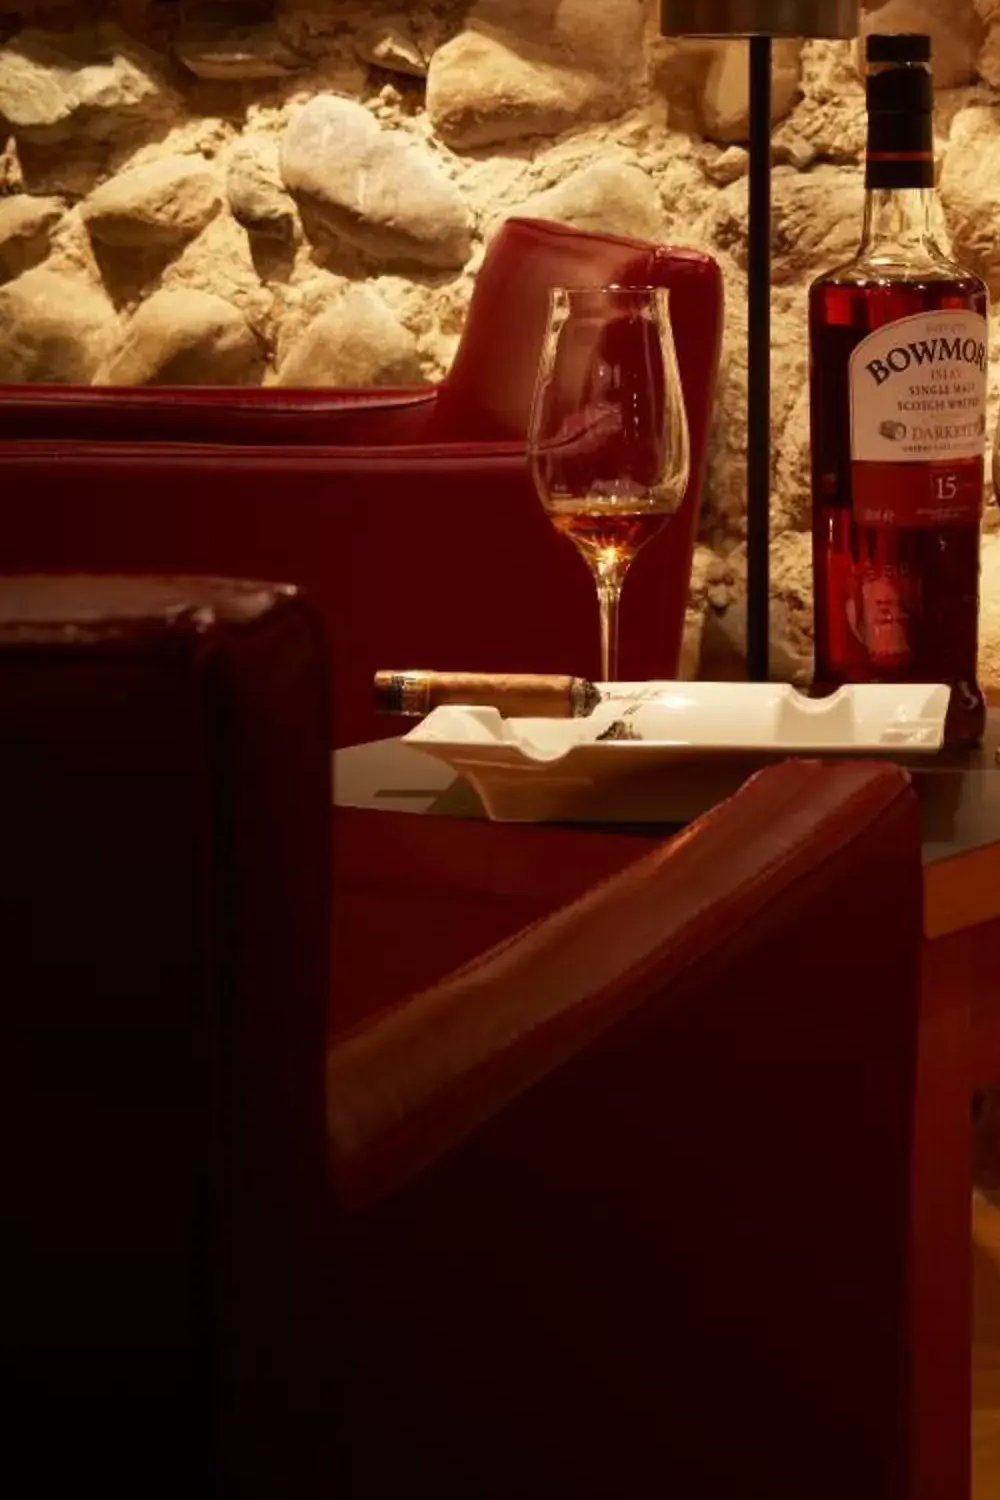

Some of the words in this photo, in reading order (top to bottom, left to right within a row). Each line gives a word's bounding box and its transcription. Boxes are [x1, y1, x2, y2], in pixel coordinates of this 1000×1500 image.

[864, 336, 987, 387] BOWMOR
[909, 384, 949, 396] SINGLE
[936, 475, 957, 500] 15
